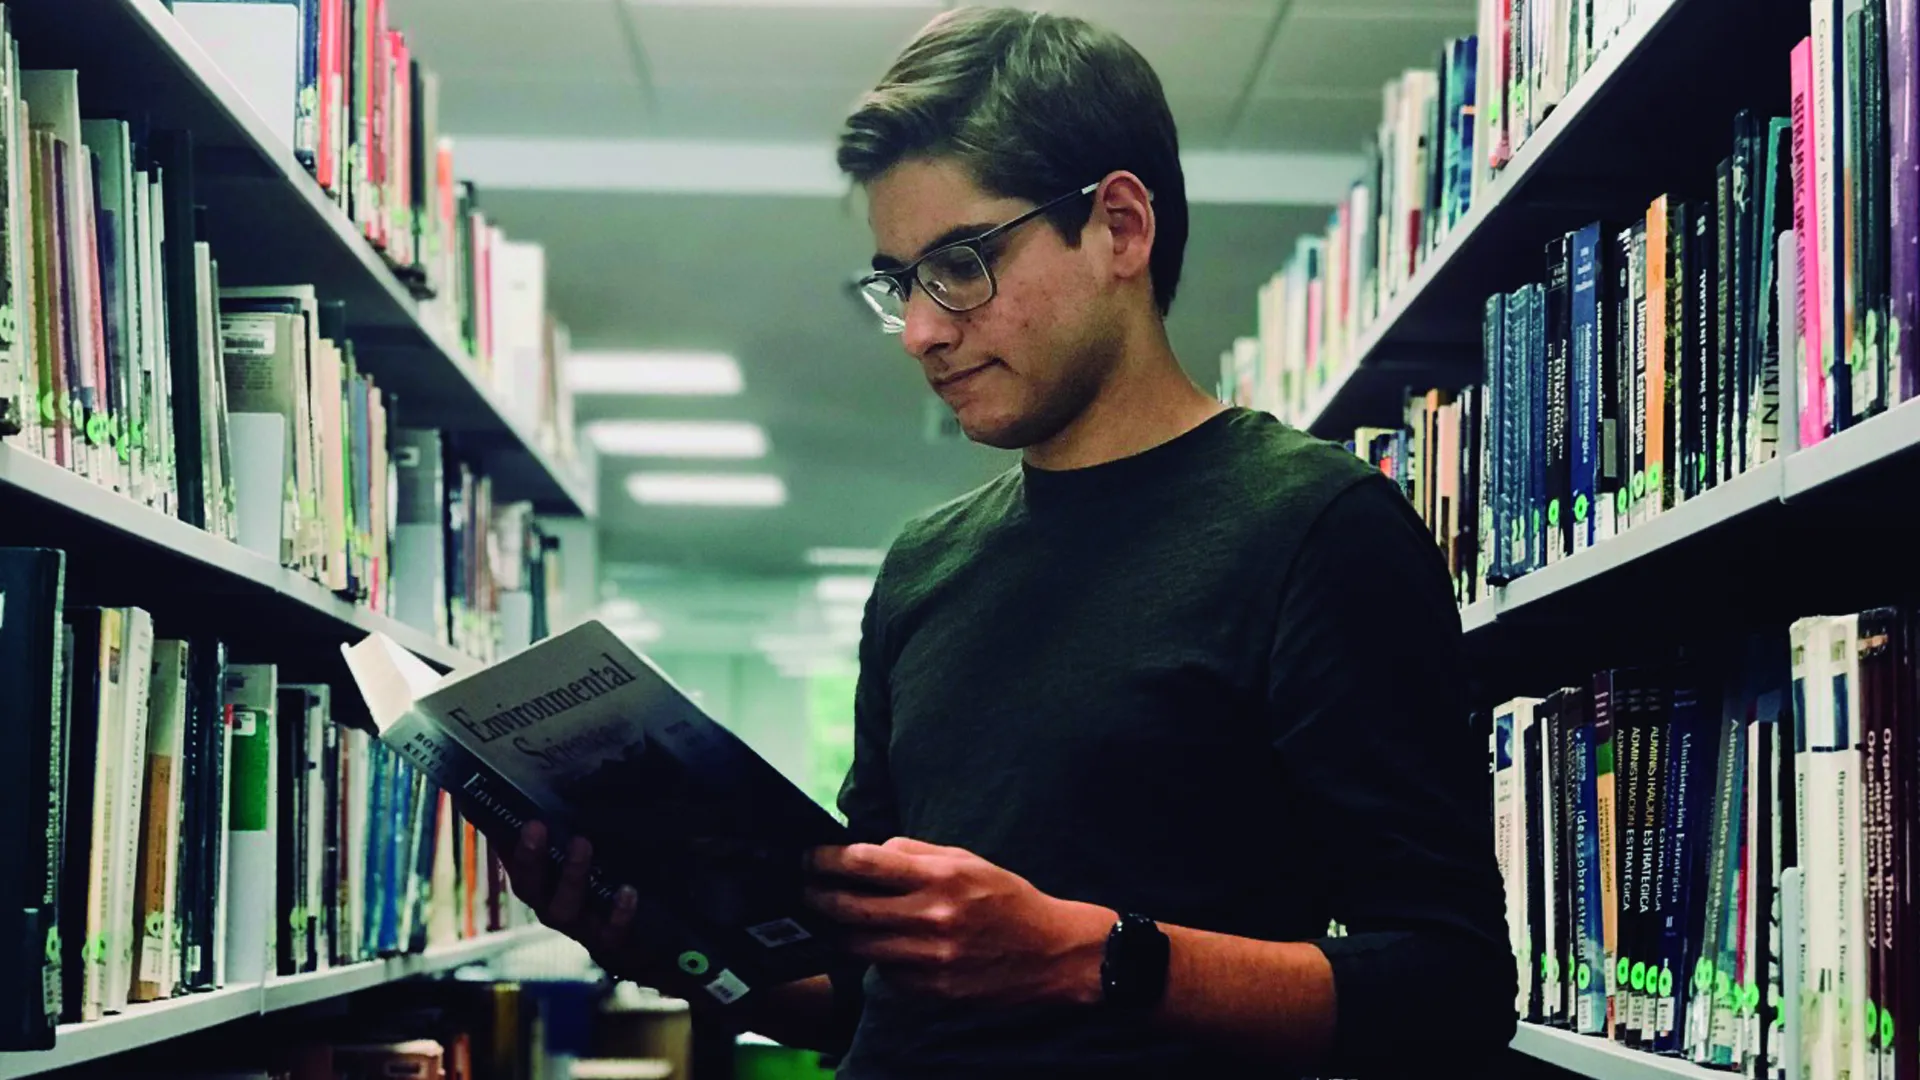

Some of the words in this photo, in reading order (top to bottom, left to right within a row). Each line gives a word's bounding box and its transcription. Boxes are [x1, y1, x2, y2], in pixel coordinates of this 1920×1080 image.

[1793, 92, 1805, 203] REFRAMING
[1820, 172, 1828, 252] Business
[1637, 299, 1647, 369] Dirección
[1635, 372, 1646, 454] Estratégica
[449, 653, 637, 743] Environmental
[513, 722, 624, 770] Science
[1676, 732, 1691, 828] Administración
[1718, 719, 1740, 846] Administración
[1576, 810, 1586, 847] Ideas
[1837, 770, 1847, 866] Organization
[1867, 730, 1876, 868] Organization
[1882, 728, 1894, 868] Organization
[43, 807, 57, 904] Engineering
[1577, 853, 1587, 891] sobre
[1623, 828, 1634, 911] ESTRATÉGICA
[1672, 833, 1685, 903] Estratégica
[1837, 871, 1846, 921] Theory
[1869, 874, 1878, 949] Theory
[1884, 873, 1894, 950] Theory
